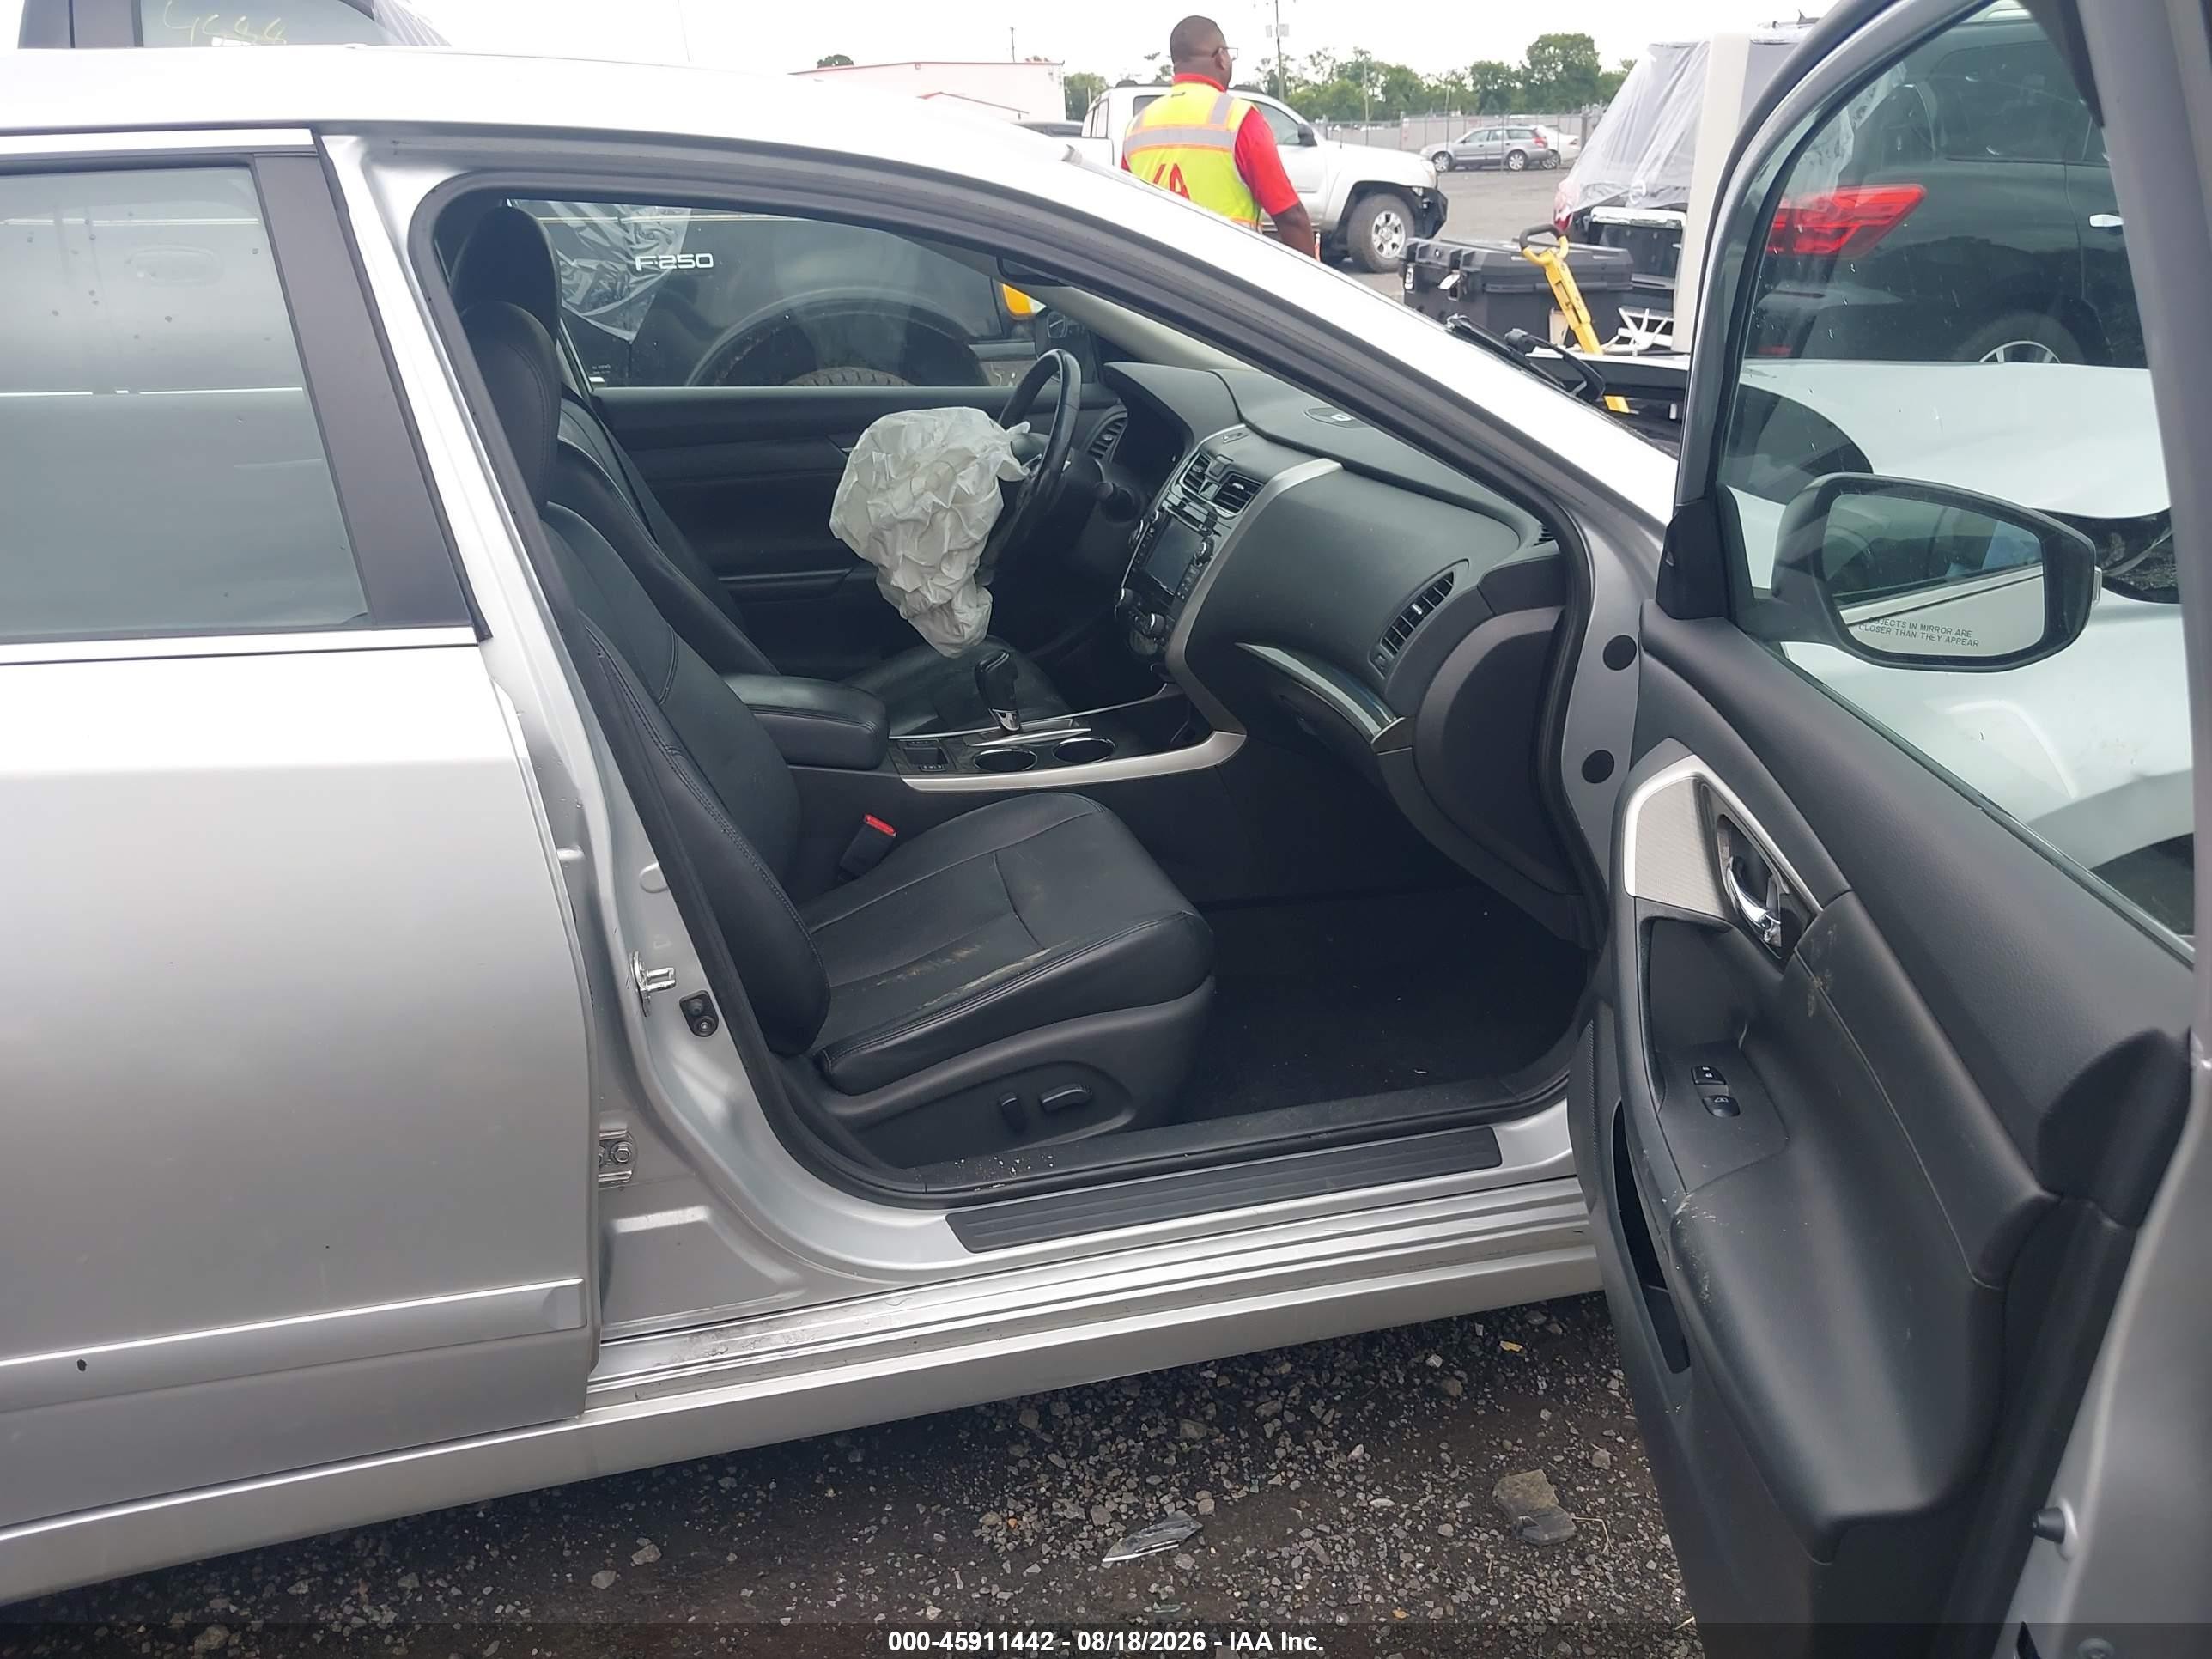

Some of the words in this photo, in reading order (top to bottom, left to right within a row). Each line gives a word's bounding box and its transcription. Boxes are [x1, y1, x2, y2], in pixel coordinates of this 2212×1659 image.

[1858, 624, 1892, 634] CLOSER
[1895, 629, 1917, 639] THAN
[1921, 632, 1942, 641] THEY
[1945, 636, 1979, 647] APPEAR
[1920, 624, 1953, 635] MIRROR
[1954, 629, 1972, 638] ARE
